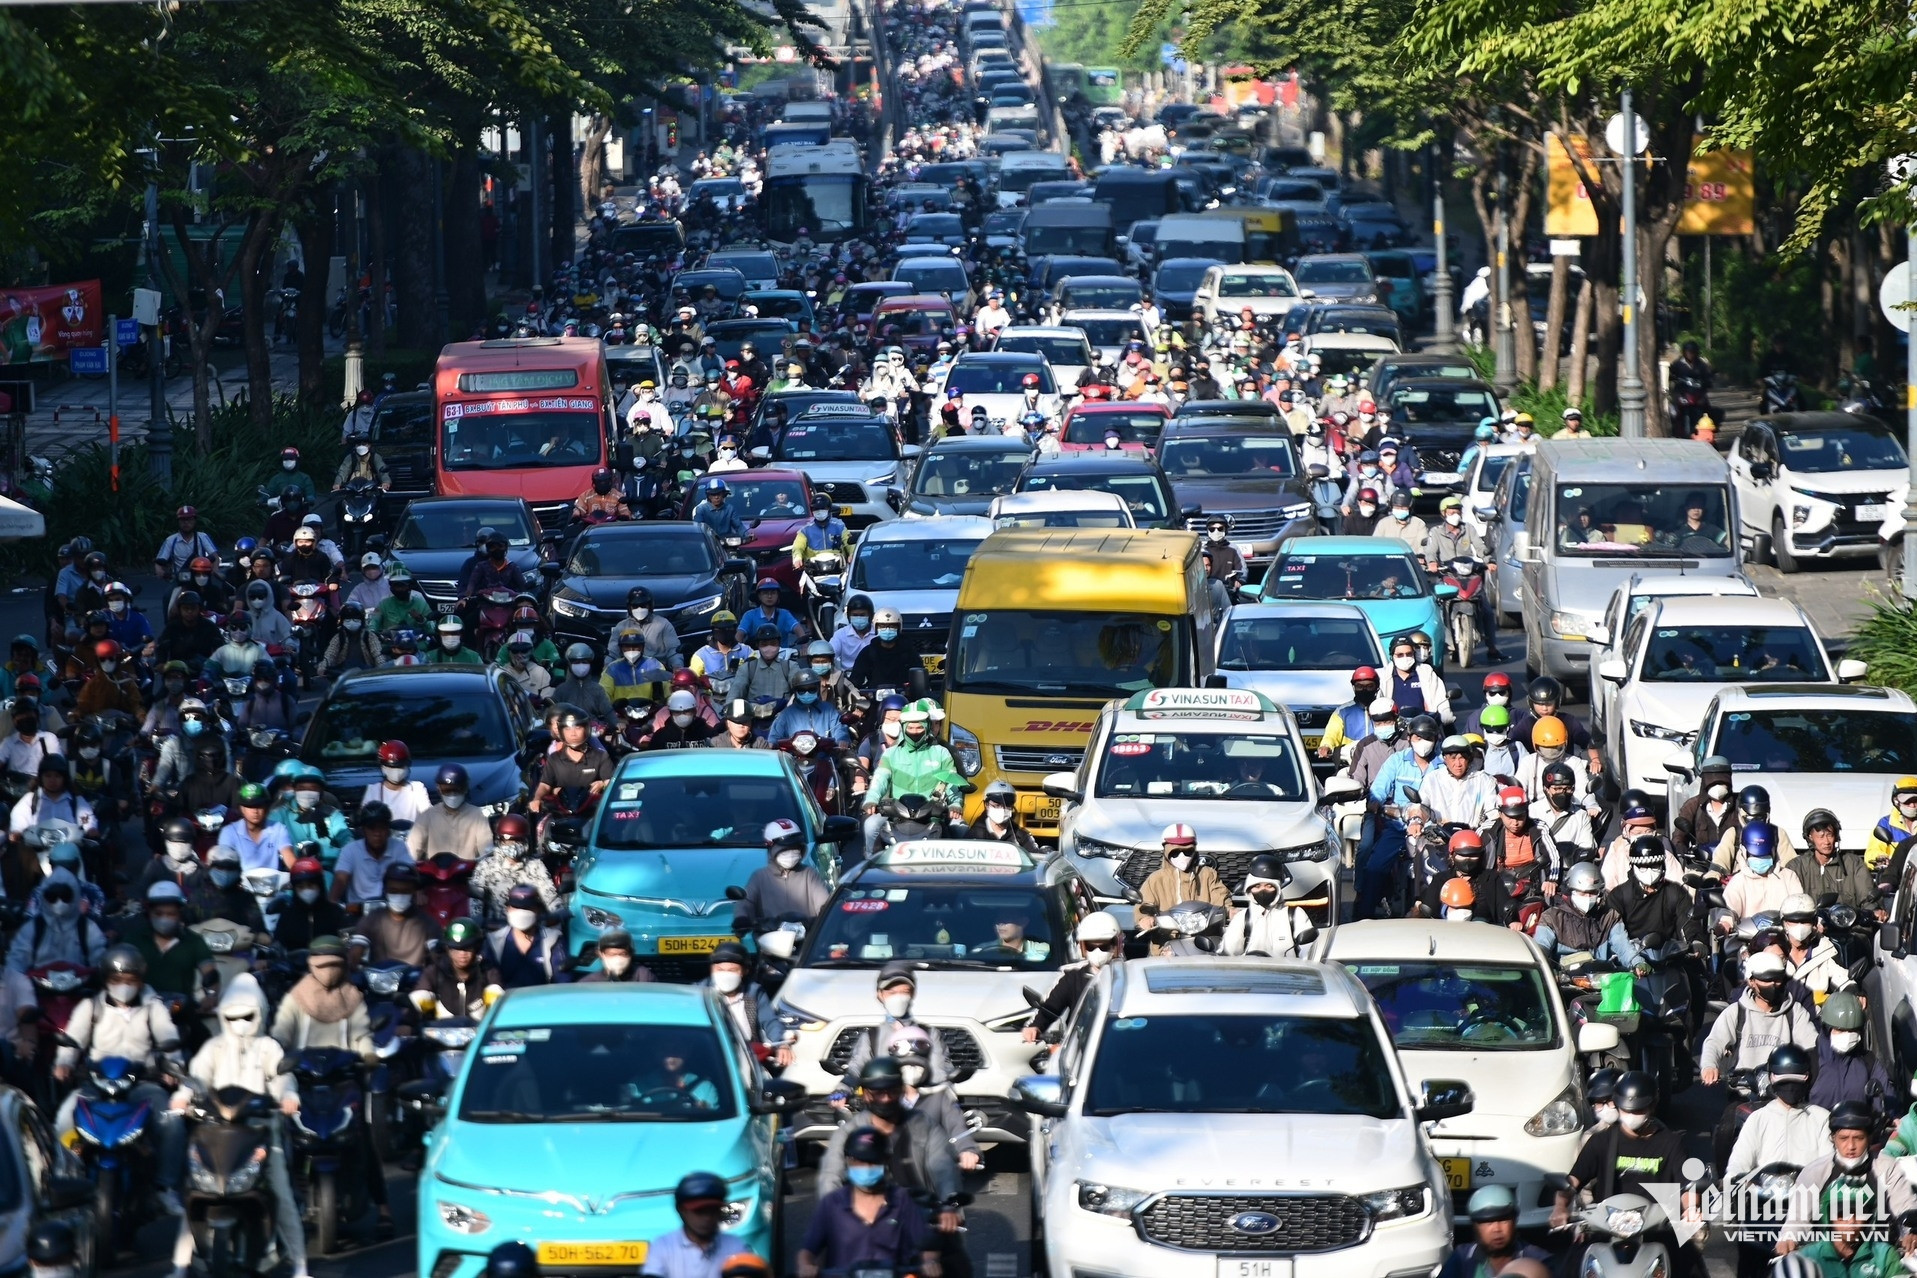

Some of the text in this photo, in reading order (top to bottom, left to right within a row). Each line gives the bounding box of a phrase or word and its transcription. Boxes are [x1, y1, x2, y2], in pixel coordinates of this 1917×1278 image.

[569, 400, 594, 410] GIANG
[1172, 694, 1253, 705] VINASUN TAXI
[1024, 721, 1094, 732] DHL
[1049, 756, 1068, 764] Ford
[615, 811, 640, 819] TAXI
[921, 847, 1016, 860] VINASUN TAXI
[1442, 1159, 1452, 1172] G
[1176, 1178, 1336, 1187] EVEREST
[548, 1245, 640, 1260] 50H-562.70
[1240, 1262, 1272, 1277] 51H
